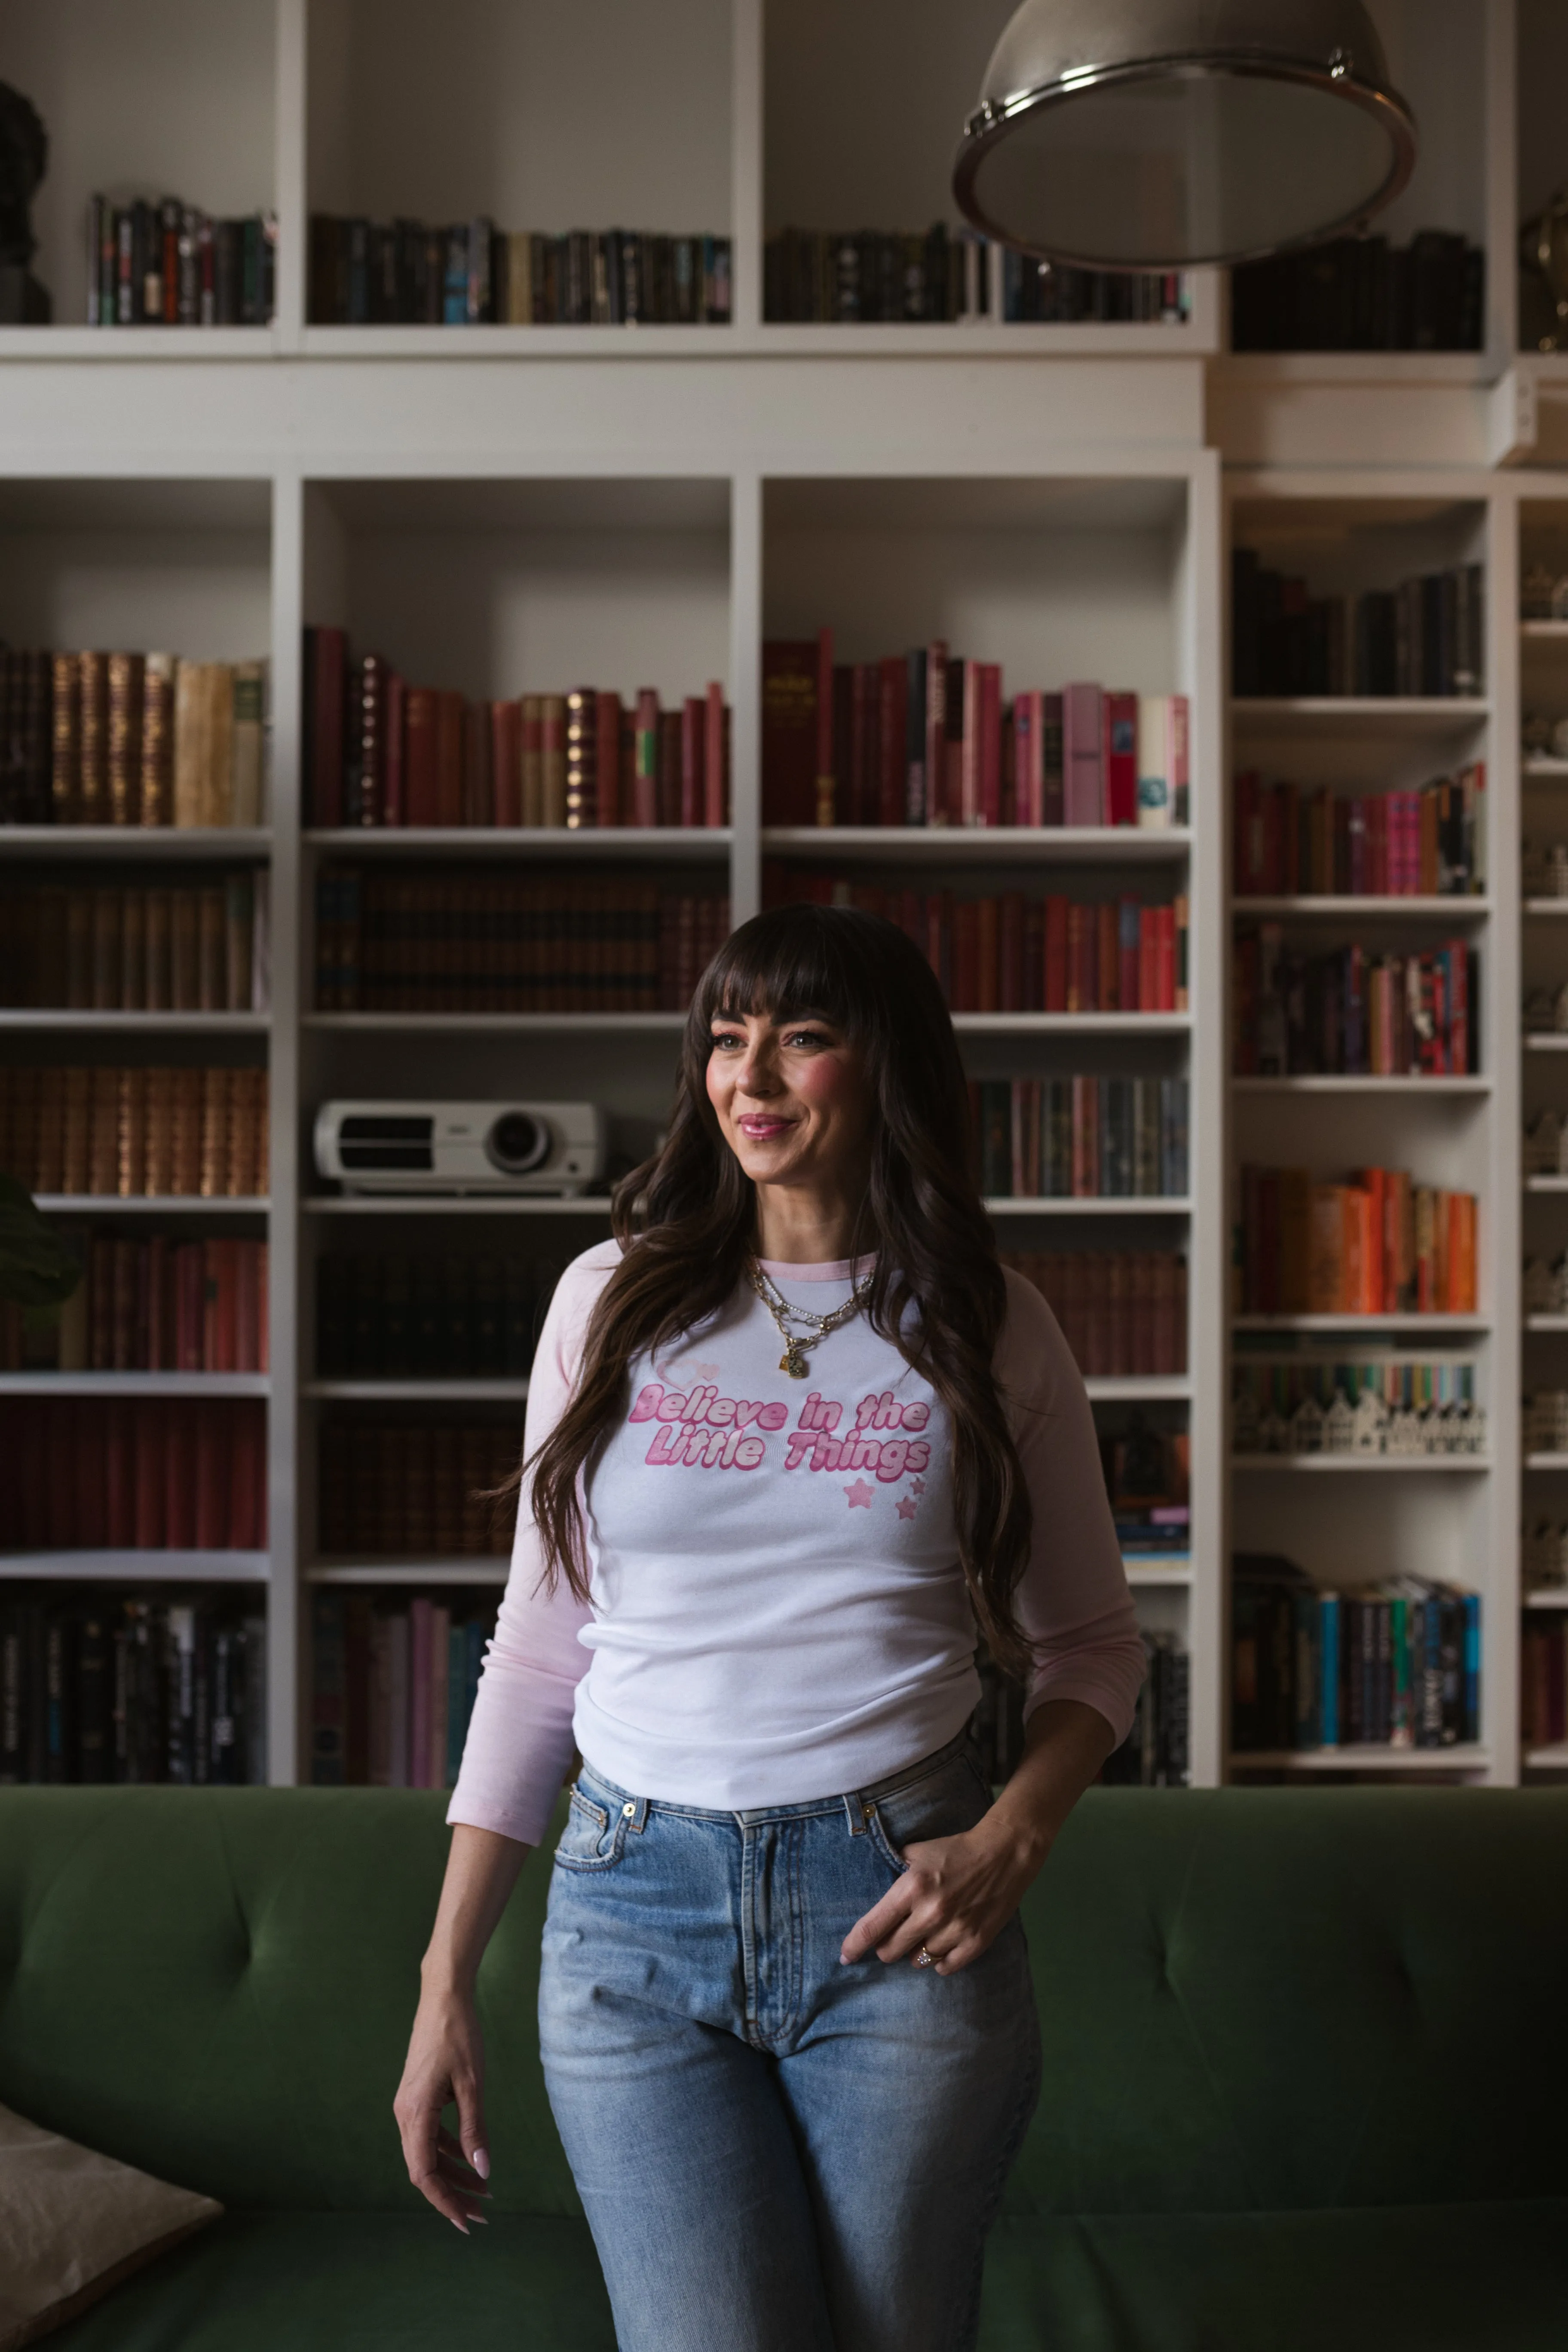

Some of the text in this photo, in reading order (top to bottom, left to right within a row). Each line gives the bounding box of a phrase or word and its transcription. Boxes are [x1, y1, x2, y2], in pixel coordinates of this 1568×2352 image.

[628, 1384, 930, 1432] Believe in the
[645, 1422, 931, 1483] Little Things
